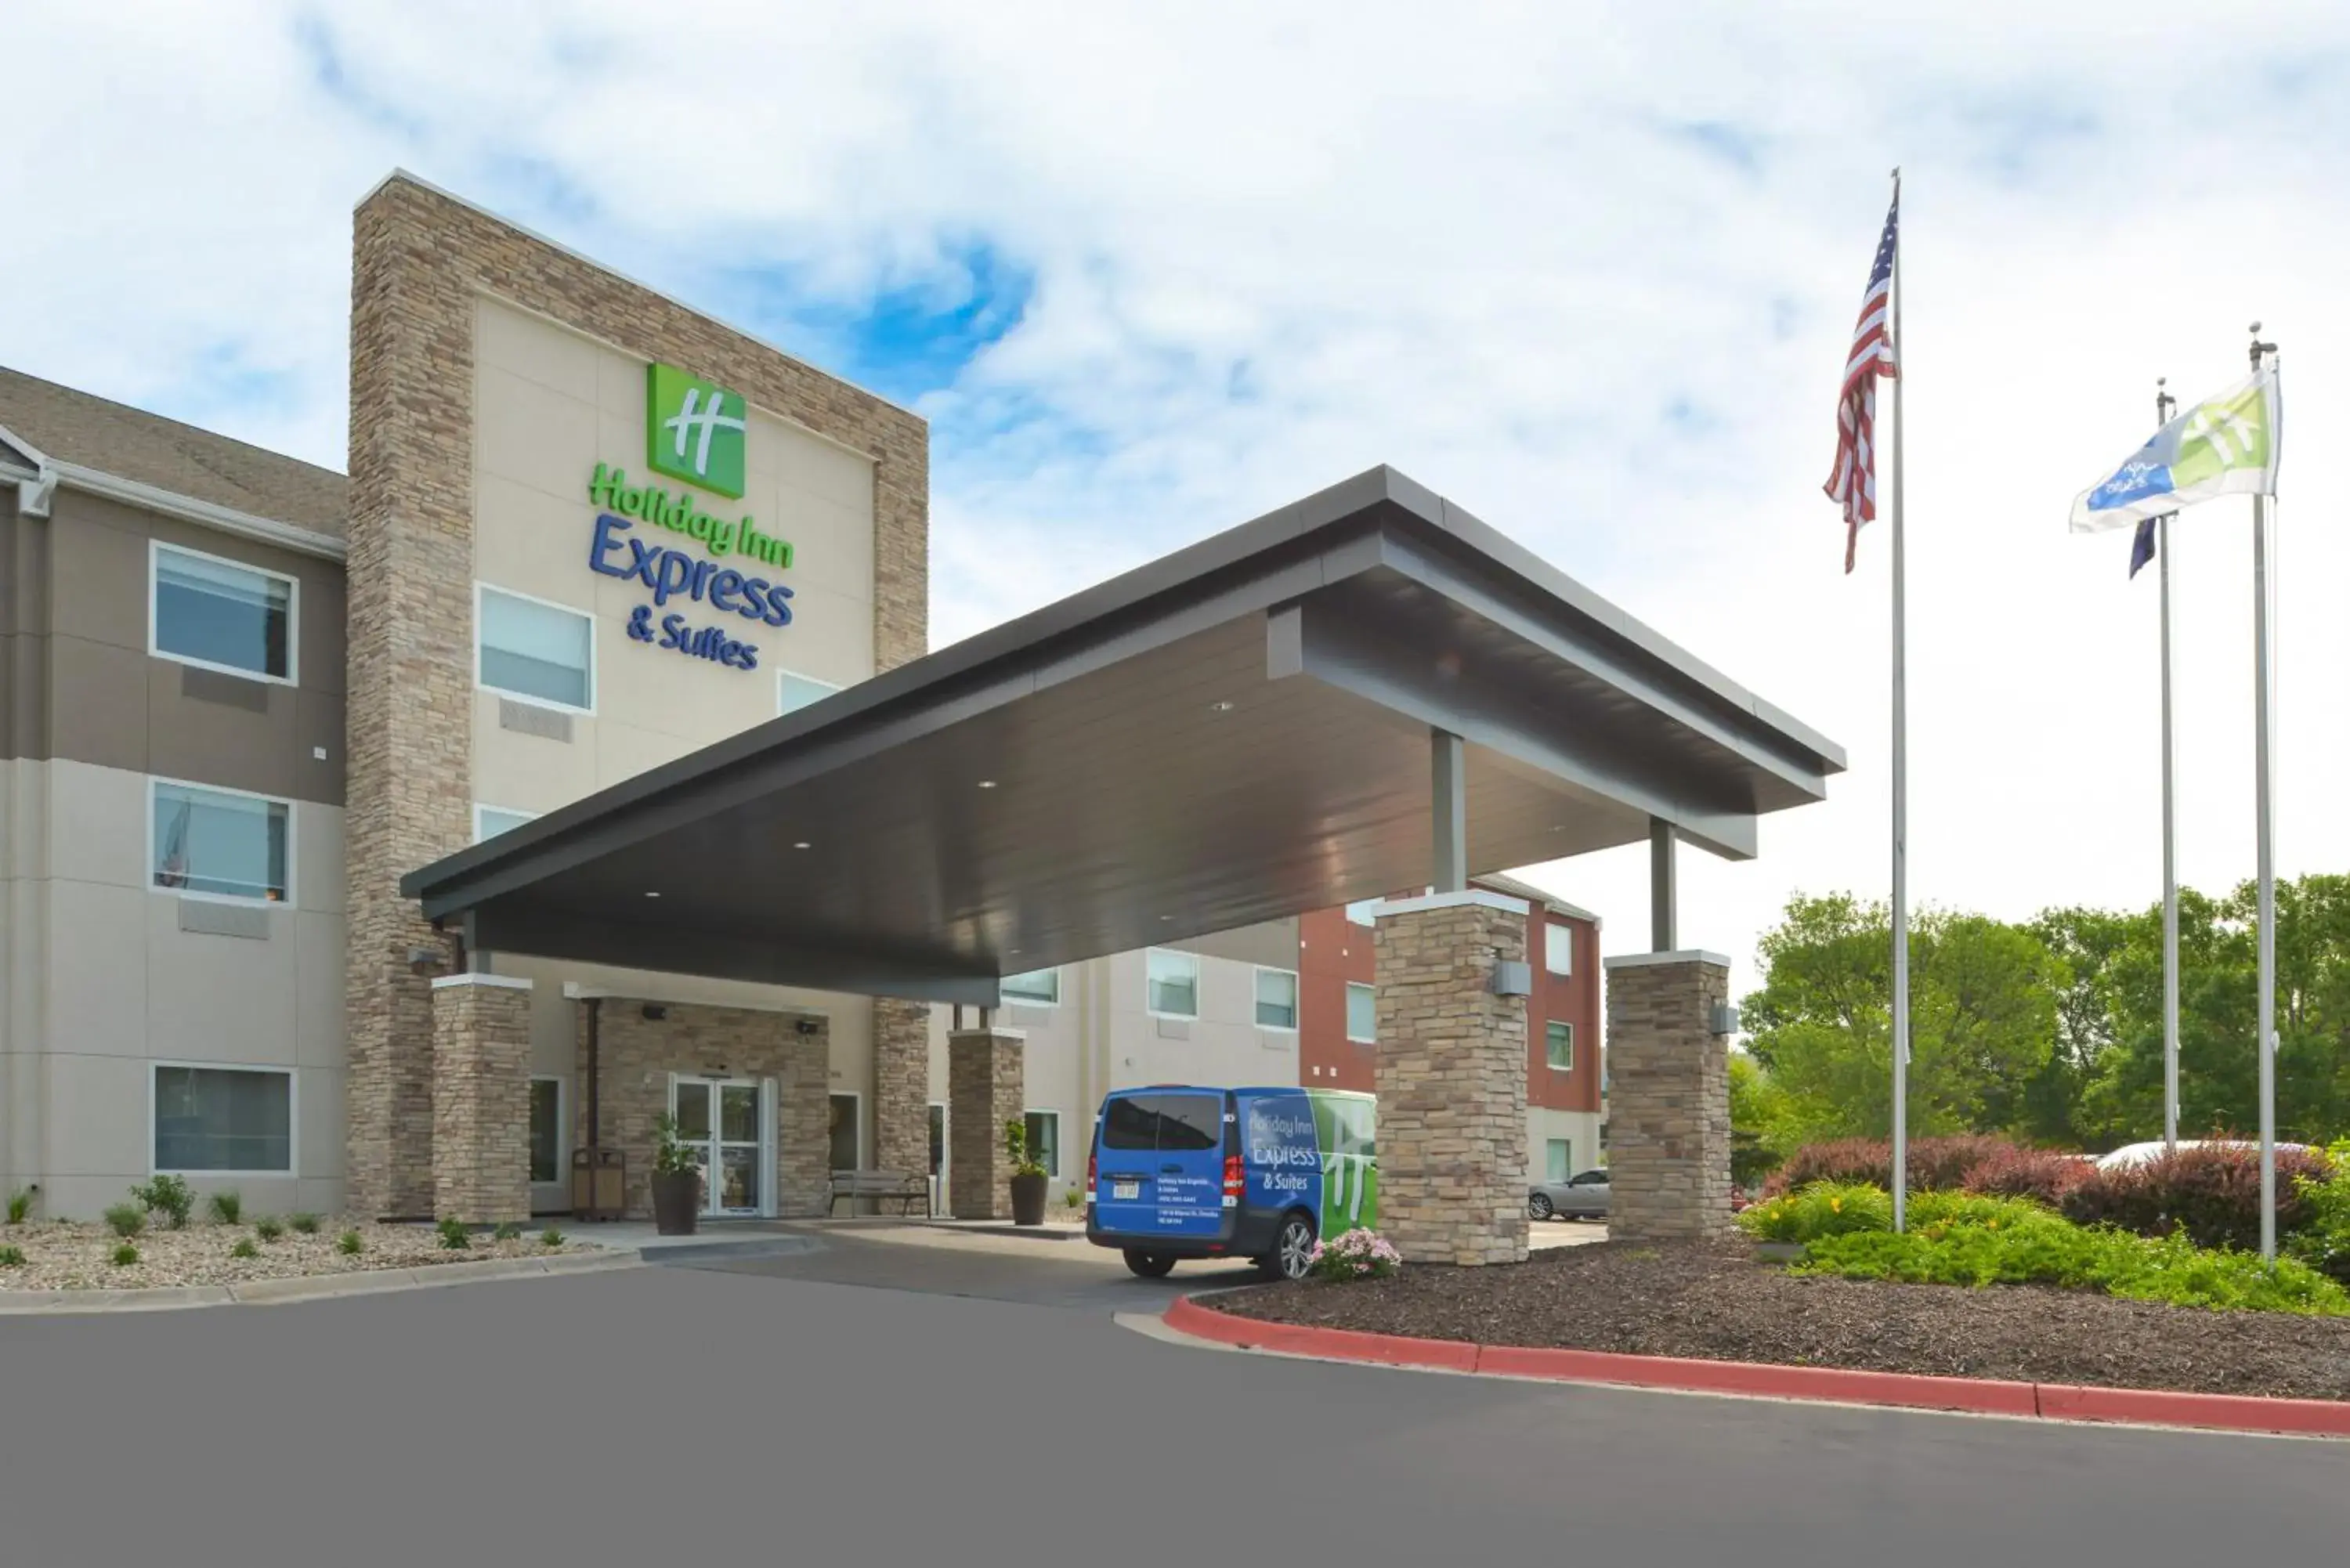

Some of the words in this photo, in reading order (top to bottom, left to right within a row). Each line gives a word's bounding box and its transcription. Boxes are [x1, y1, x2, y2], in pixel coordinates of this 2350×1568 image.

[588, 461, 736, 556] Holiday
[737, 515, 794, 569] Inn
[589, 512, 794, 627] Express
[627, 604, 655, 643] &
[659, 613, 759, 671] Suites
[1251, 1110, 1293, 1136] Holiday
[1295, 1115, 1312, 1135] Inn
[1253, 1138, 1316, 1170] Express
[1263, 1172, 1273, 1190] &
[1274, 1173, 1307, 1190] Suites
